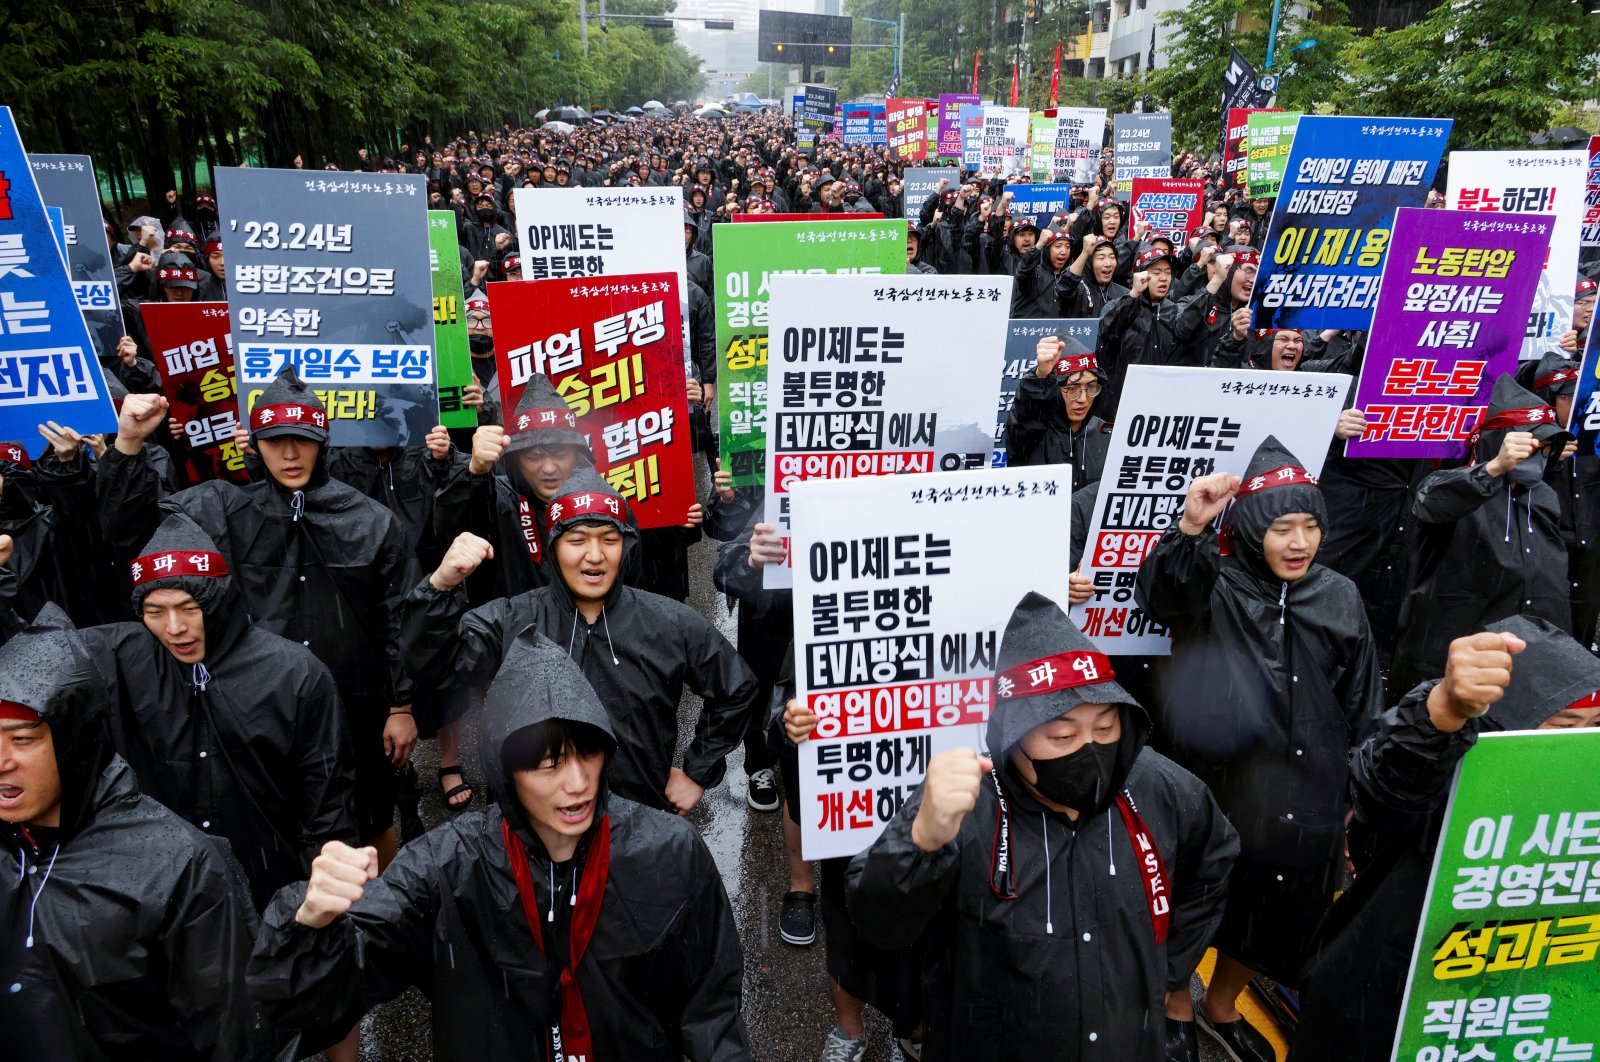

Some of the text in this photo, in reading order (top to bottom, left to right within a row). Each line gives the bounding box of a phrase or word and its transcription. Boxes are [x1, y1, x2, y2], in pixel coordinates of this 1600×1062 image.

[1117, 142, 1161, 153] 병합조건으로
[1117, 156, 1140, 165] 약속한
[1117, 168, 1169, 179] 휴가일수 보상
[1296, 157, 1429, 187] 연예인 병에 빠진
[1138, 193, 1197, 210] 삼성전자
[1287, 189, 1358, 216] 바지회장
[1456, 187, 1557, 213] 분노하라!
[528, 223, 615, 251] OPI제도는
[1144, 212, 1188, 229] 직원은
[235, 264, 396, 296] 병합조건으로
[1410, 247, 1516, 279] 노동탄압
[726, 271, 750, 298] 이
[1402, 282, 1505, 315] 앞장서는
[238, 307, 322, 337] 약속한
[1417, 320, 1482, 350] 사측!
[162, 338, 220, 377] 파업
[507, 300, 667, 388] 파업 투쟁
[782, 326, 905, 364] OPI제도는
[244, 347, 430, 380] 휴가일수 보상
[1382, 358, 1489, 397] 분노로
[554, 352, 646, 419] 승리!
[782, 371, 886, 408] 불투명한
[184, 410, 238, 448] 임금
[258, 406, 326, 428] 총파업
[517, 411, 577, 431] 총파업
[780, 412, 937, 451] EVA방식 에서
[1127, 414, 1241, 452] OPI제도는
[602, 406, 674, 464] 협약
[549, 494, 620, 522] 총파업
[131, 554, 210, 582] 총파업
[809, 532, 952, 583] OPI제도는
[812, 585, 933, 637] 불투명한
[811, 630, 997, 688] EVA방식 에서
[997, 655, 1099, 698] 총파업
[813, 681, 991, 739] 영업이익방식
[816, 734, 932, 786] 투명하게
[1462, 814, 1514, 861] 이
[1136, 832, 1170, 916] NSEU
[1432, 912, 1600, 982] 성과금
[1422, 993, 1553, 1040] 직원은
